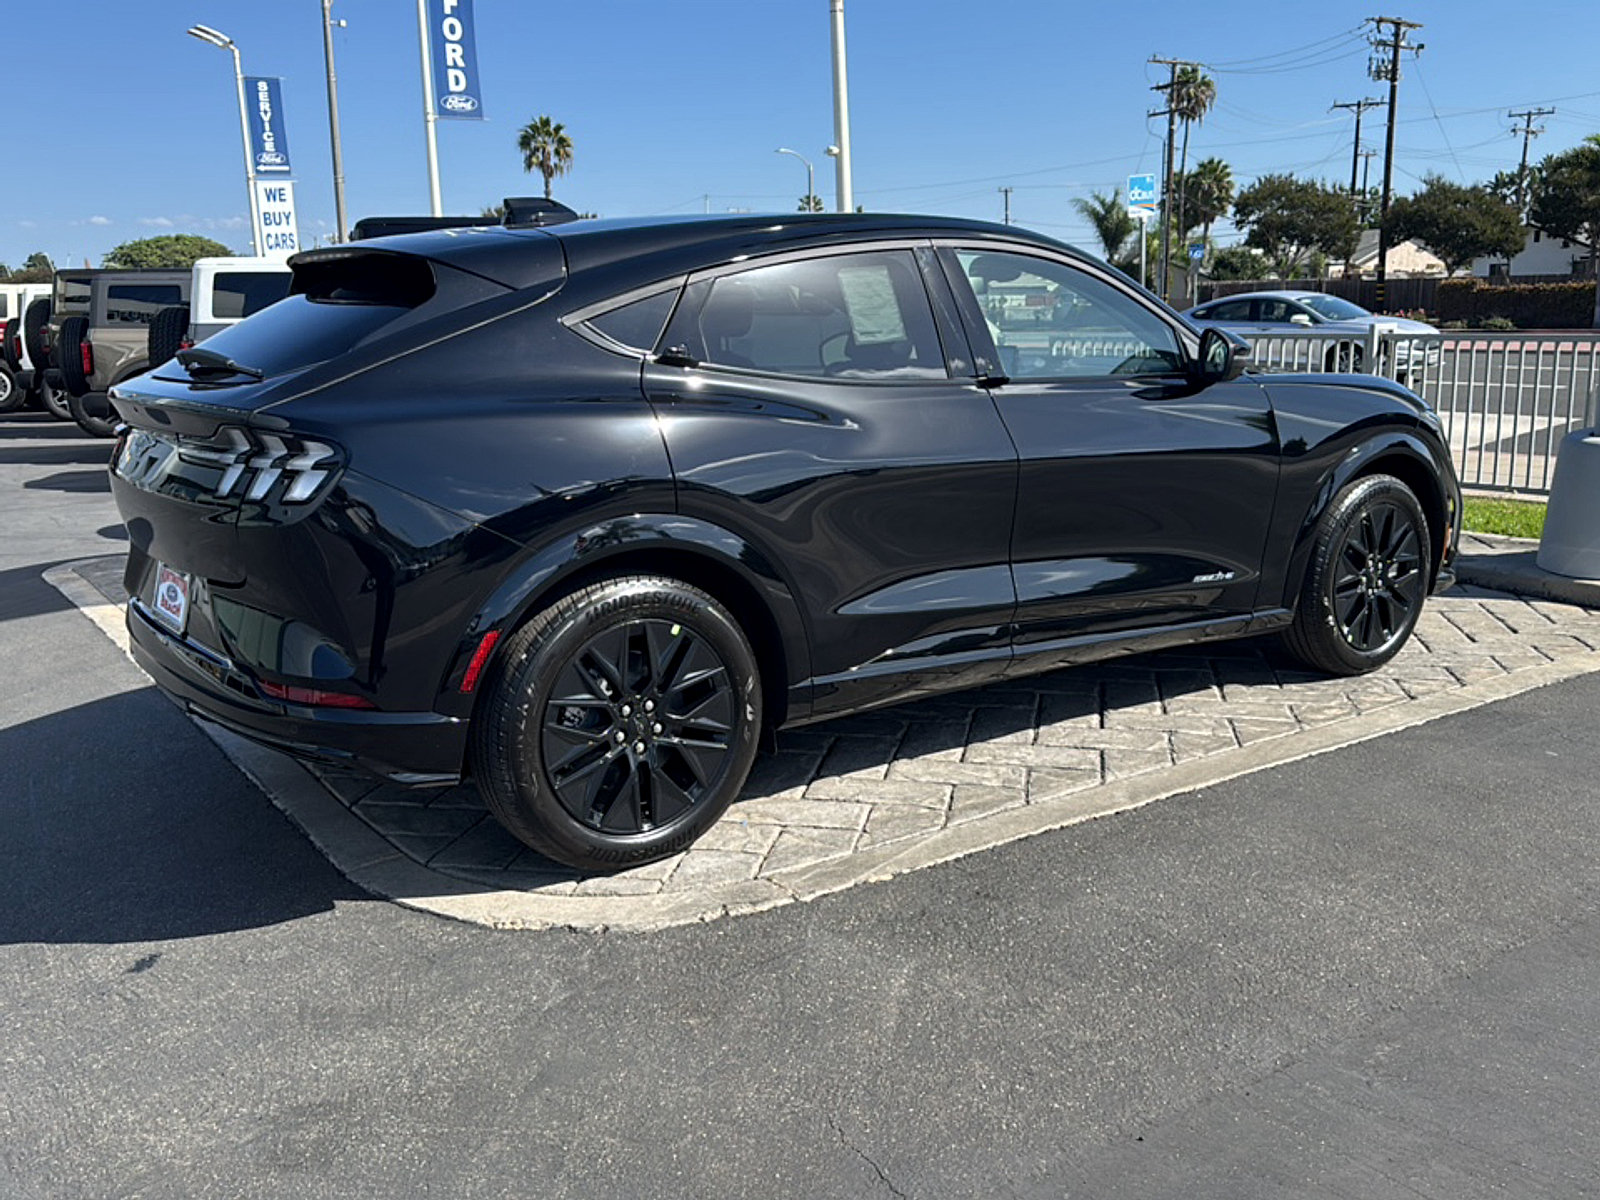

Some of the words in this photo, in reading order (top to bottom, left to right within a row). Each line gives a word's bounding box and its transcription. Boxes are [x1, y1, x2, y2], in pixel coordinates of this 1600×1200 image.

[442, 0, 467, 92] FORD
[257, 81, 275, 152] SERVICE
[264, 188, 287, 202] WE
[263, 211, 291, 226] BUY
[266, 233, 295, 250] CARS
